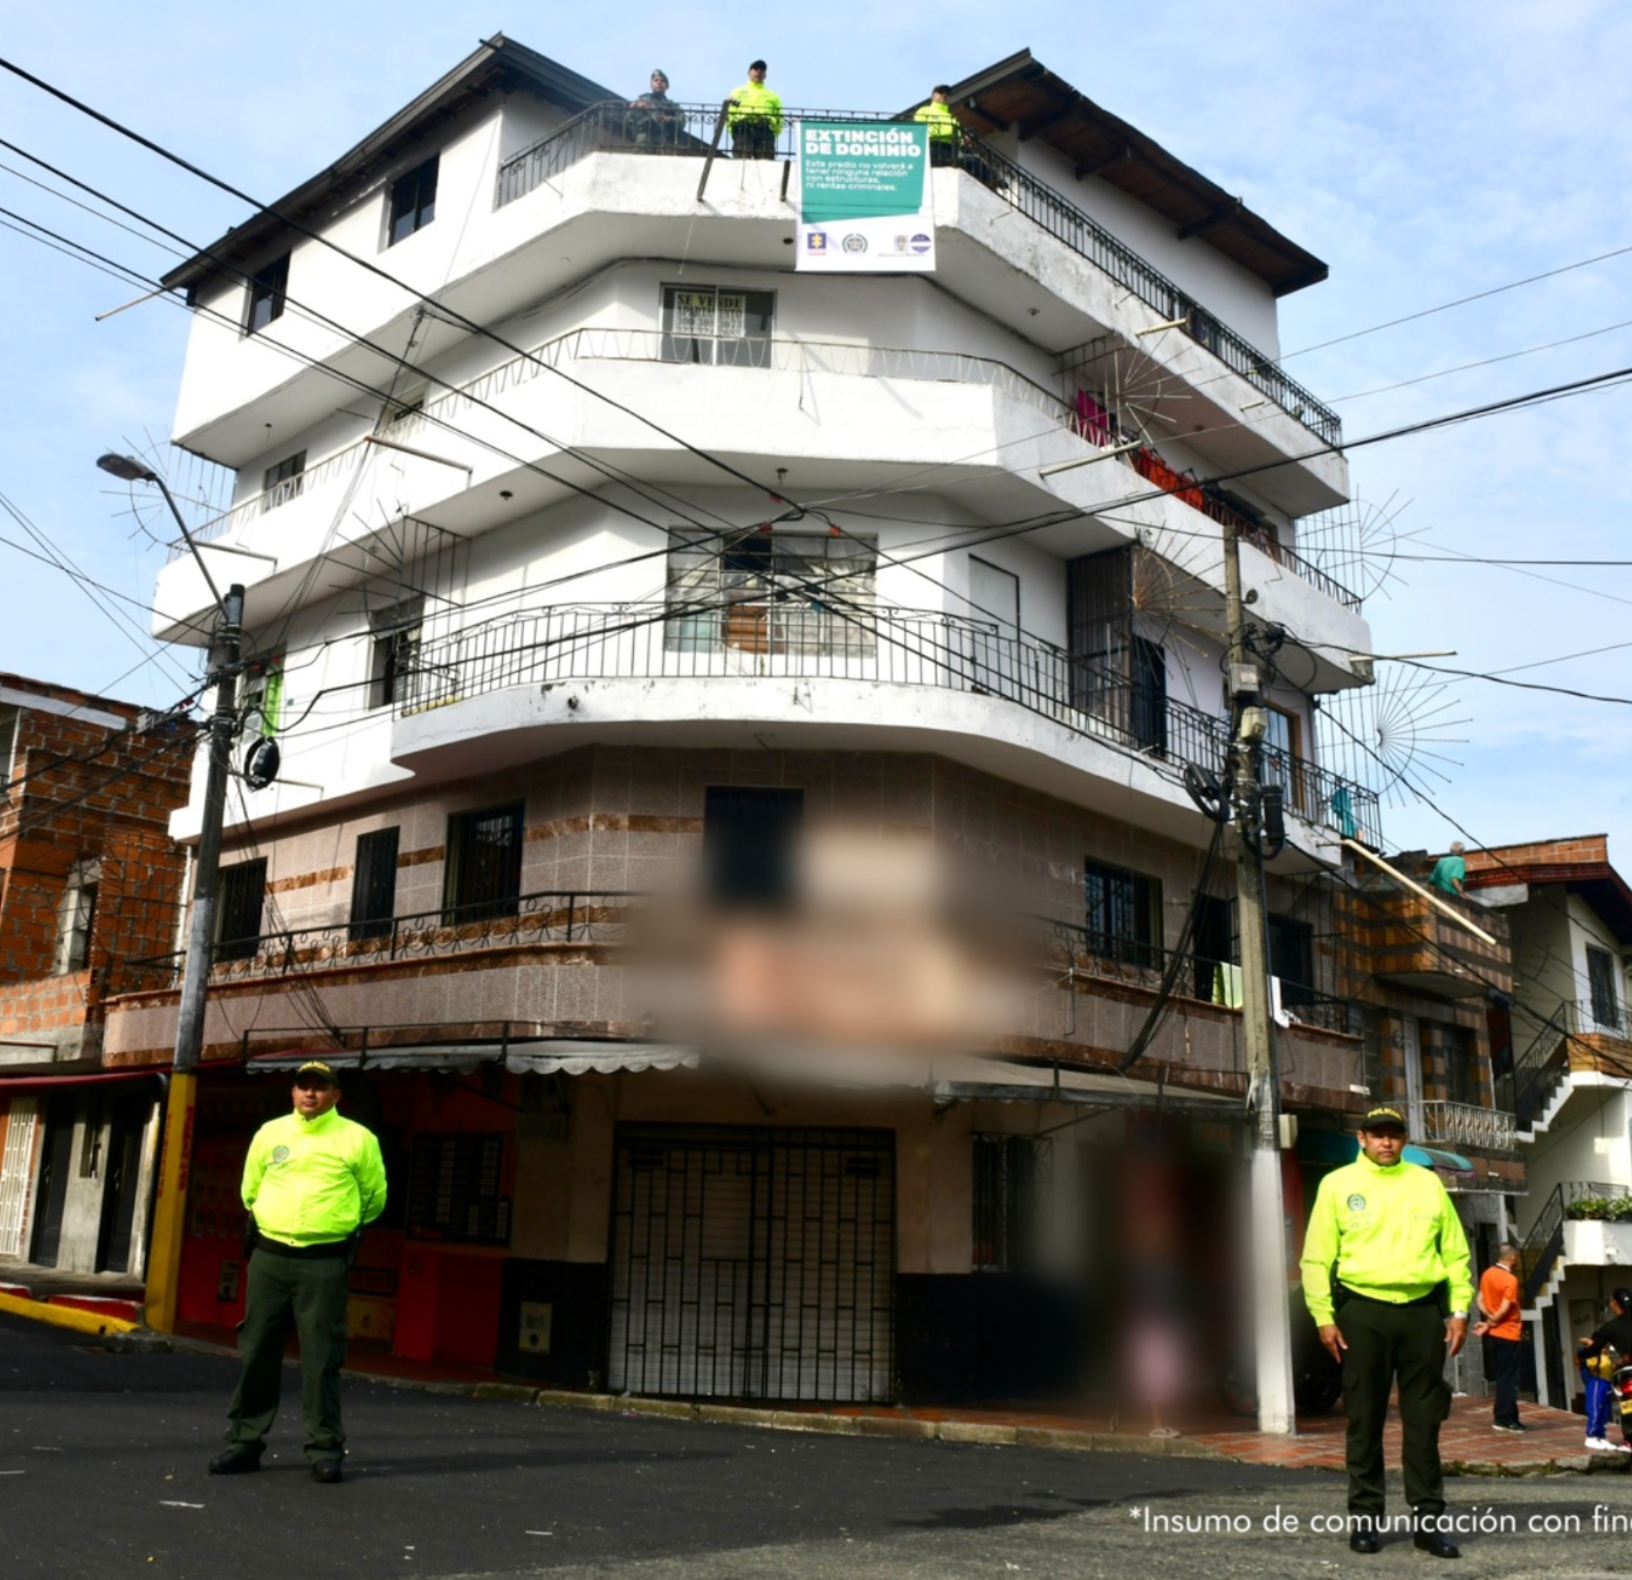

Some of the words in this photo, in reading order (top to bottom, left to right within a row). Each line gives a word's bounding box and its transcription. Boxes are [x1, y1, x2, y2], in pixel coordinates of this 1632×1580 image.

[805, 128, 914, 145] EXTINCIÓN
[805, 142, 833, 155] DE
[836, 143, 922, 158] DOMINIO
[805, 160, 826, 168] Este
[828, 161, 857, 170] predio
[873, 161, 906, 170] volverá
[805, 167, 831, 175] tener
[832, 168, 870, 177] ninguna
[872, 168, 908, 177] relación
